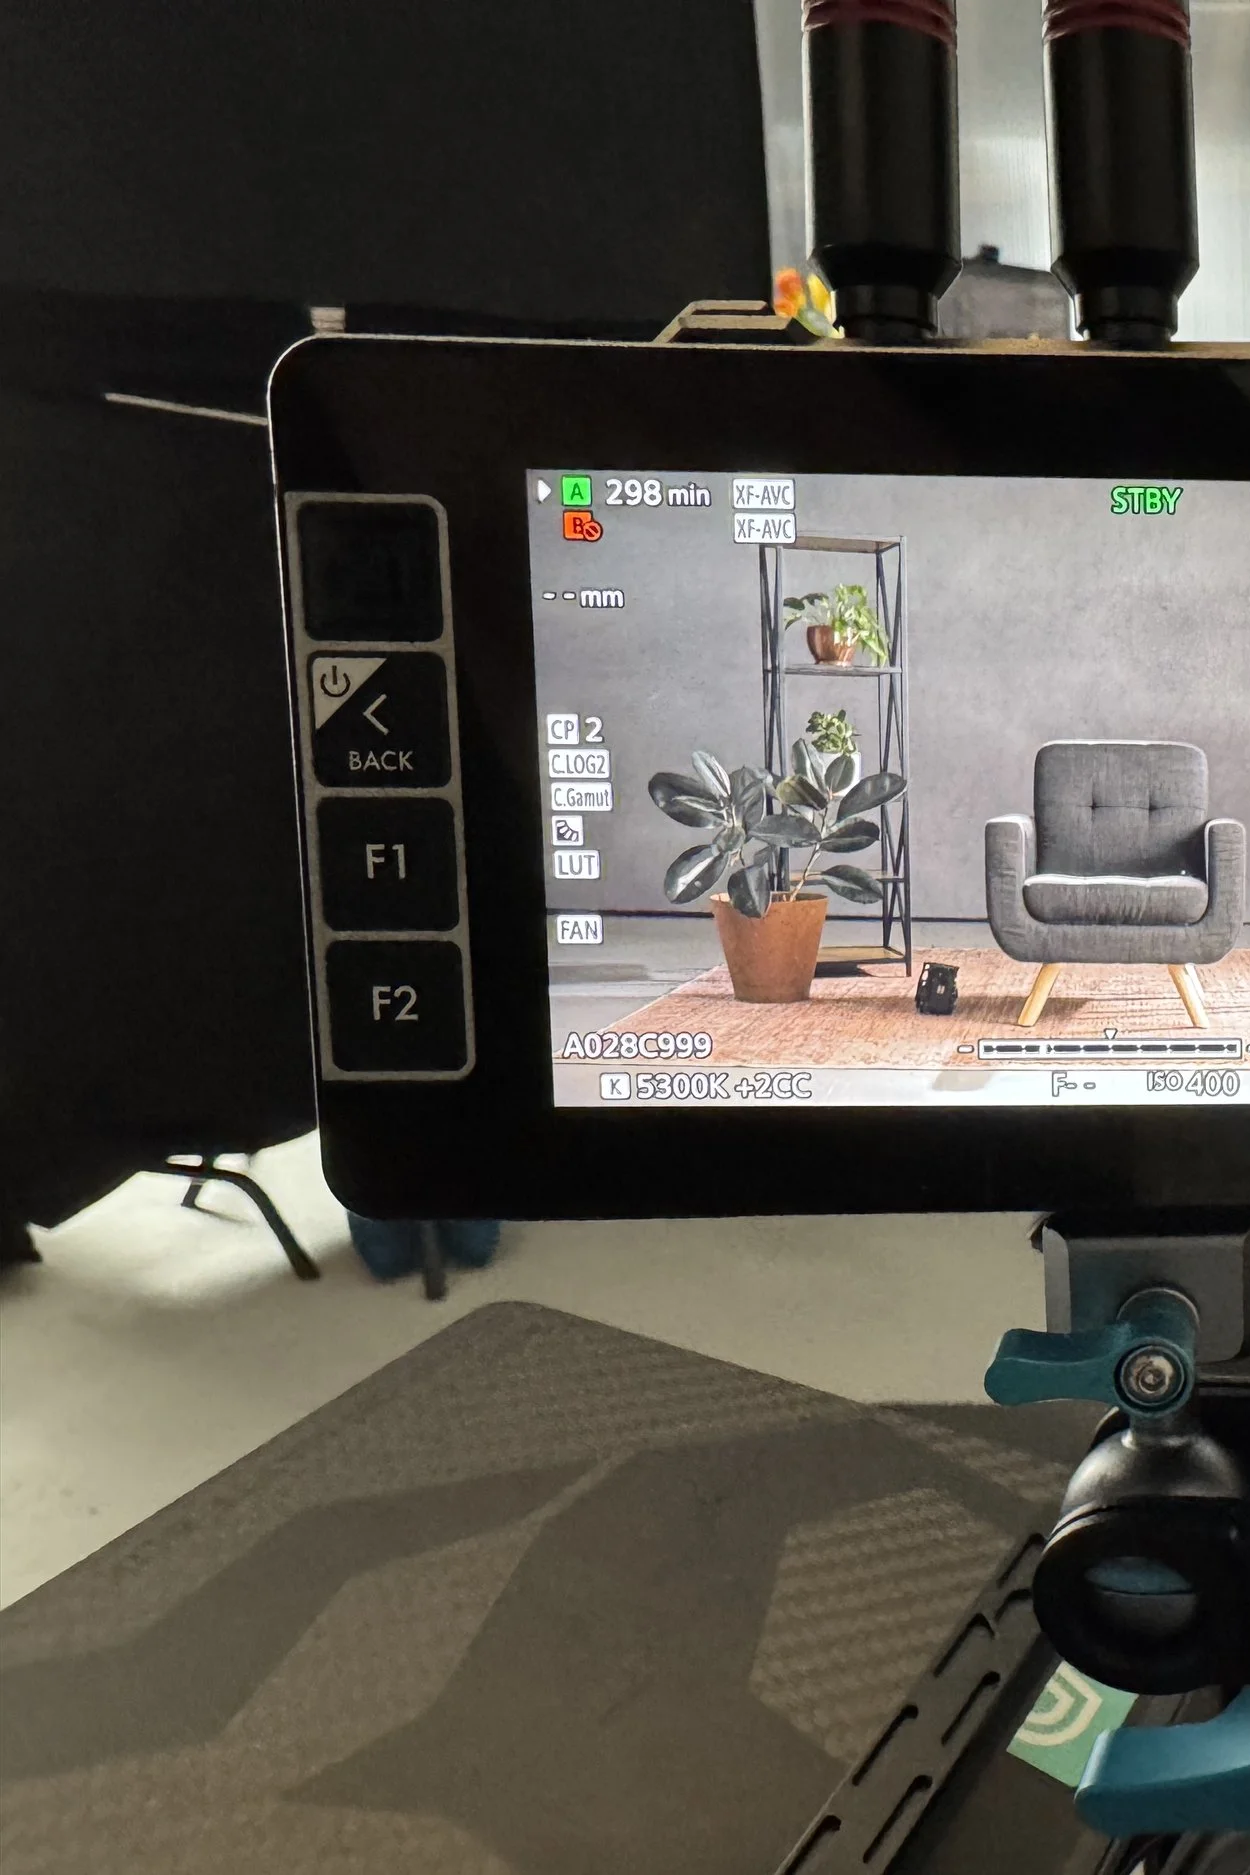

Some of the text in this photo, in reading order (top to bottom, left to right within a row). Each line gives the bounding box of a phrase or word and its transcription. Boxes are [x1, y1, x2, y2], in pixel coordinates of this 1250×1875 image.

[570, 478, 712, 507] A 298 min
[735, 484, 792, 506] XF-AVC
[1111, 486, 1183, 515] STBY
[736, 518, 793, 540] XF-AVC
[550, 716, 604, 743] CP 2
[348, 750, 414, 771] BACK
[551, 754, 606, 774] C.LOG2
[553, 787, 610, 808] C.Gamut
[365, 843, 407, 880] F1
[557, 854, 596, 876] LUT
[560, 920, 598, 940] FAN
[371, 984, 419, 1022] F2
[563, 1031, 713, 1059] A028C999
[610, 1072, 812, 1100] K 5300K +2CC
[1146, 1069, 1241, 1097] ISO 400
